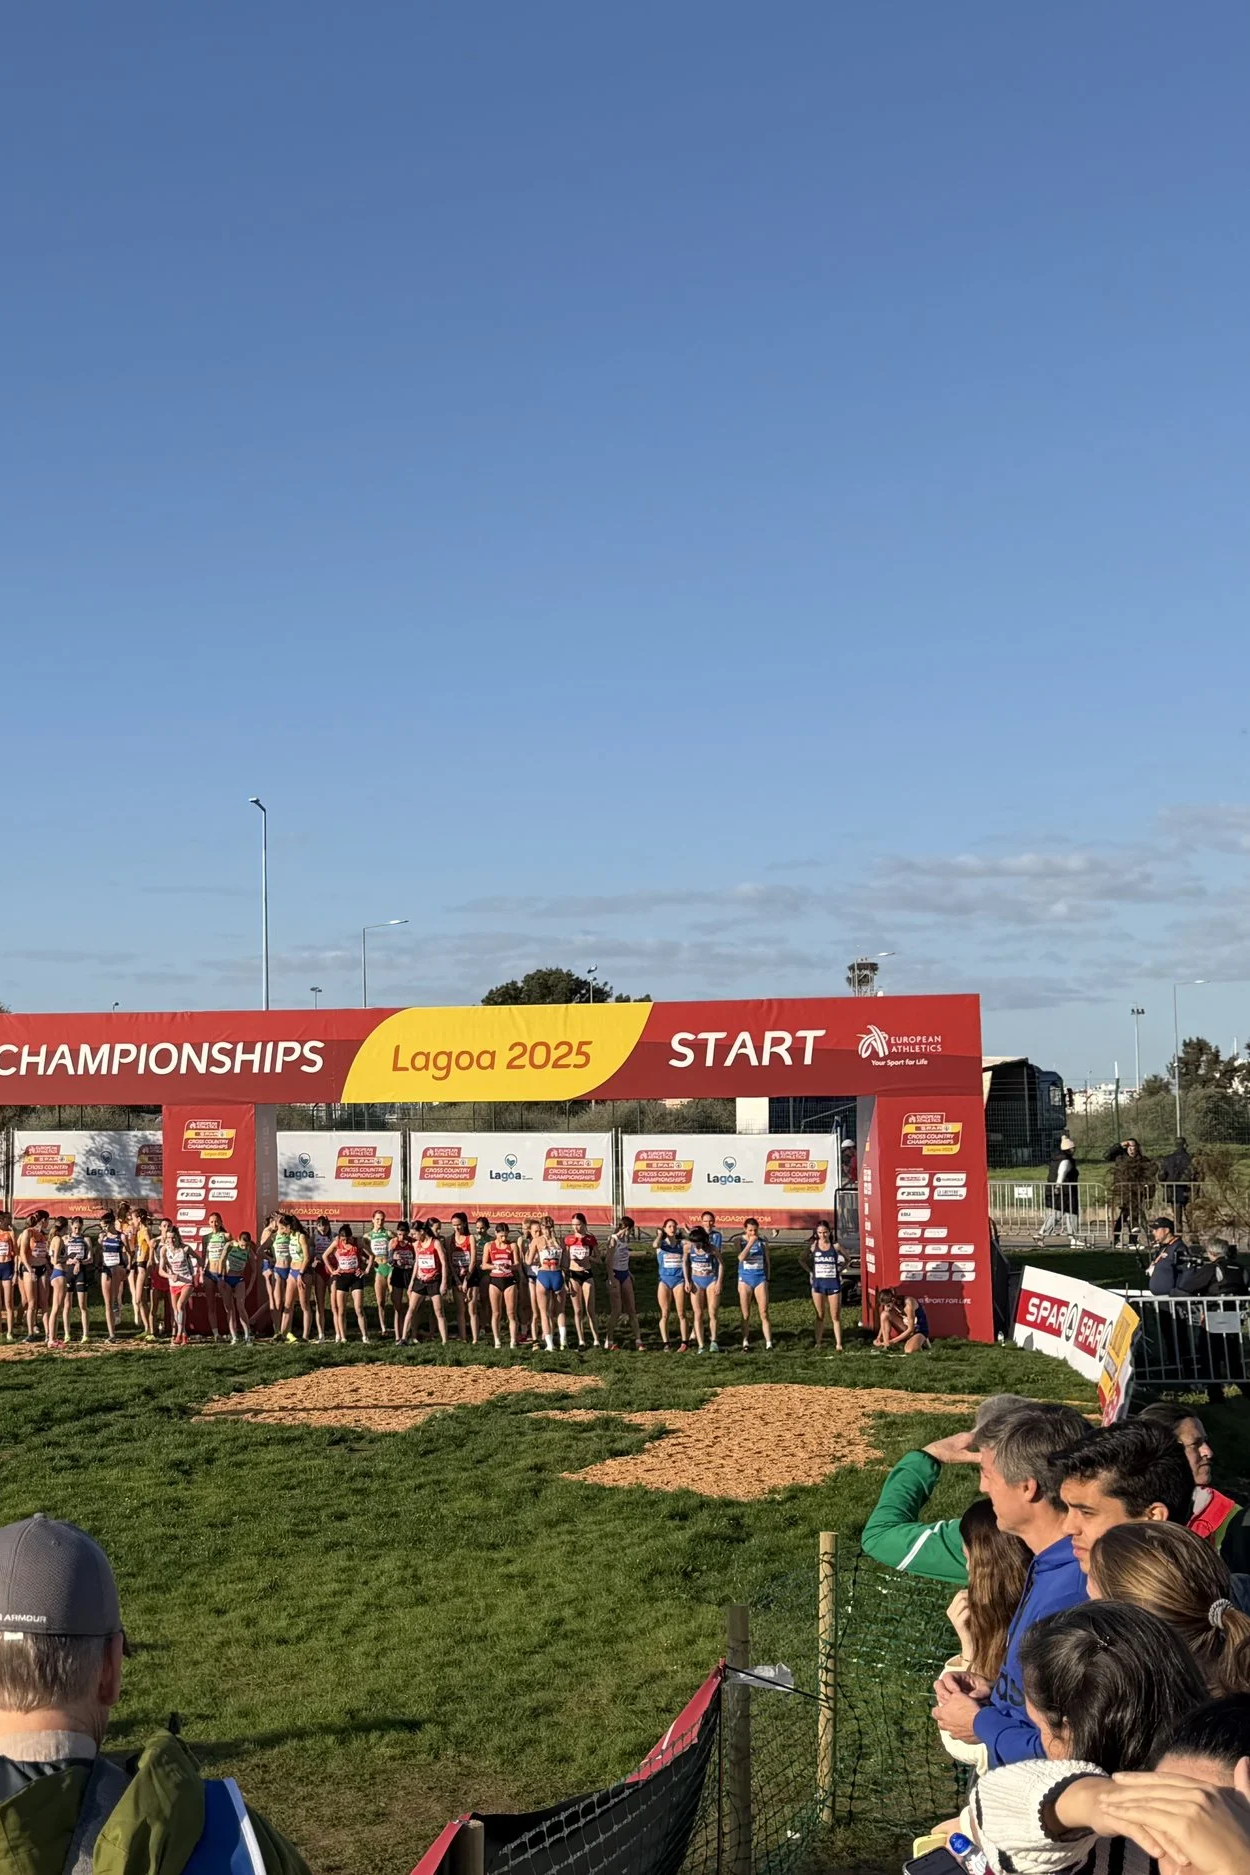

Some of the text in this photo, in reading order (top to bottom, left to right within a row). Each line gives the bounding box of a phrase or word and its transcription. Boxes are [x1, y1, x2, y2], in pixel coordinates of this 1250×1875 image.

[890, 1036, 942, 1044] EUROPEAN
[669, 1029, 825, 1068] START
[891, 1044, 942, 1052] ATHLETICS
[392, 1040, 592, 1080] Lagoa 2025
[887, 1059, 904, 1067] Sport
[86, 1167, 115, 1177] Lagoa
[284, 1169, 314, 1180] Lagoa
[490, 1170, 521, 1182] Lagoa
[707, 1173, 741, 1185] Lagoa
[1026, 1296, 1068, 1332] SPAR
[1077, 1316, 1104, 1348] SPAR
[4, 1614, 46, 1623] ARMOUR
